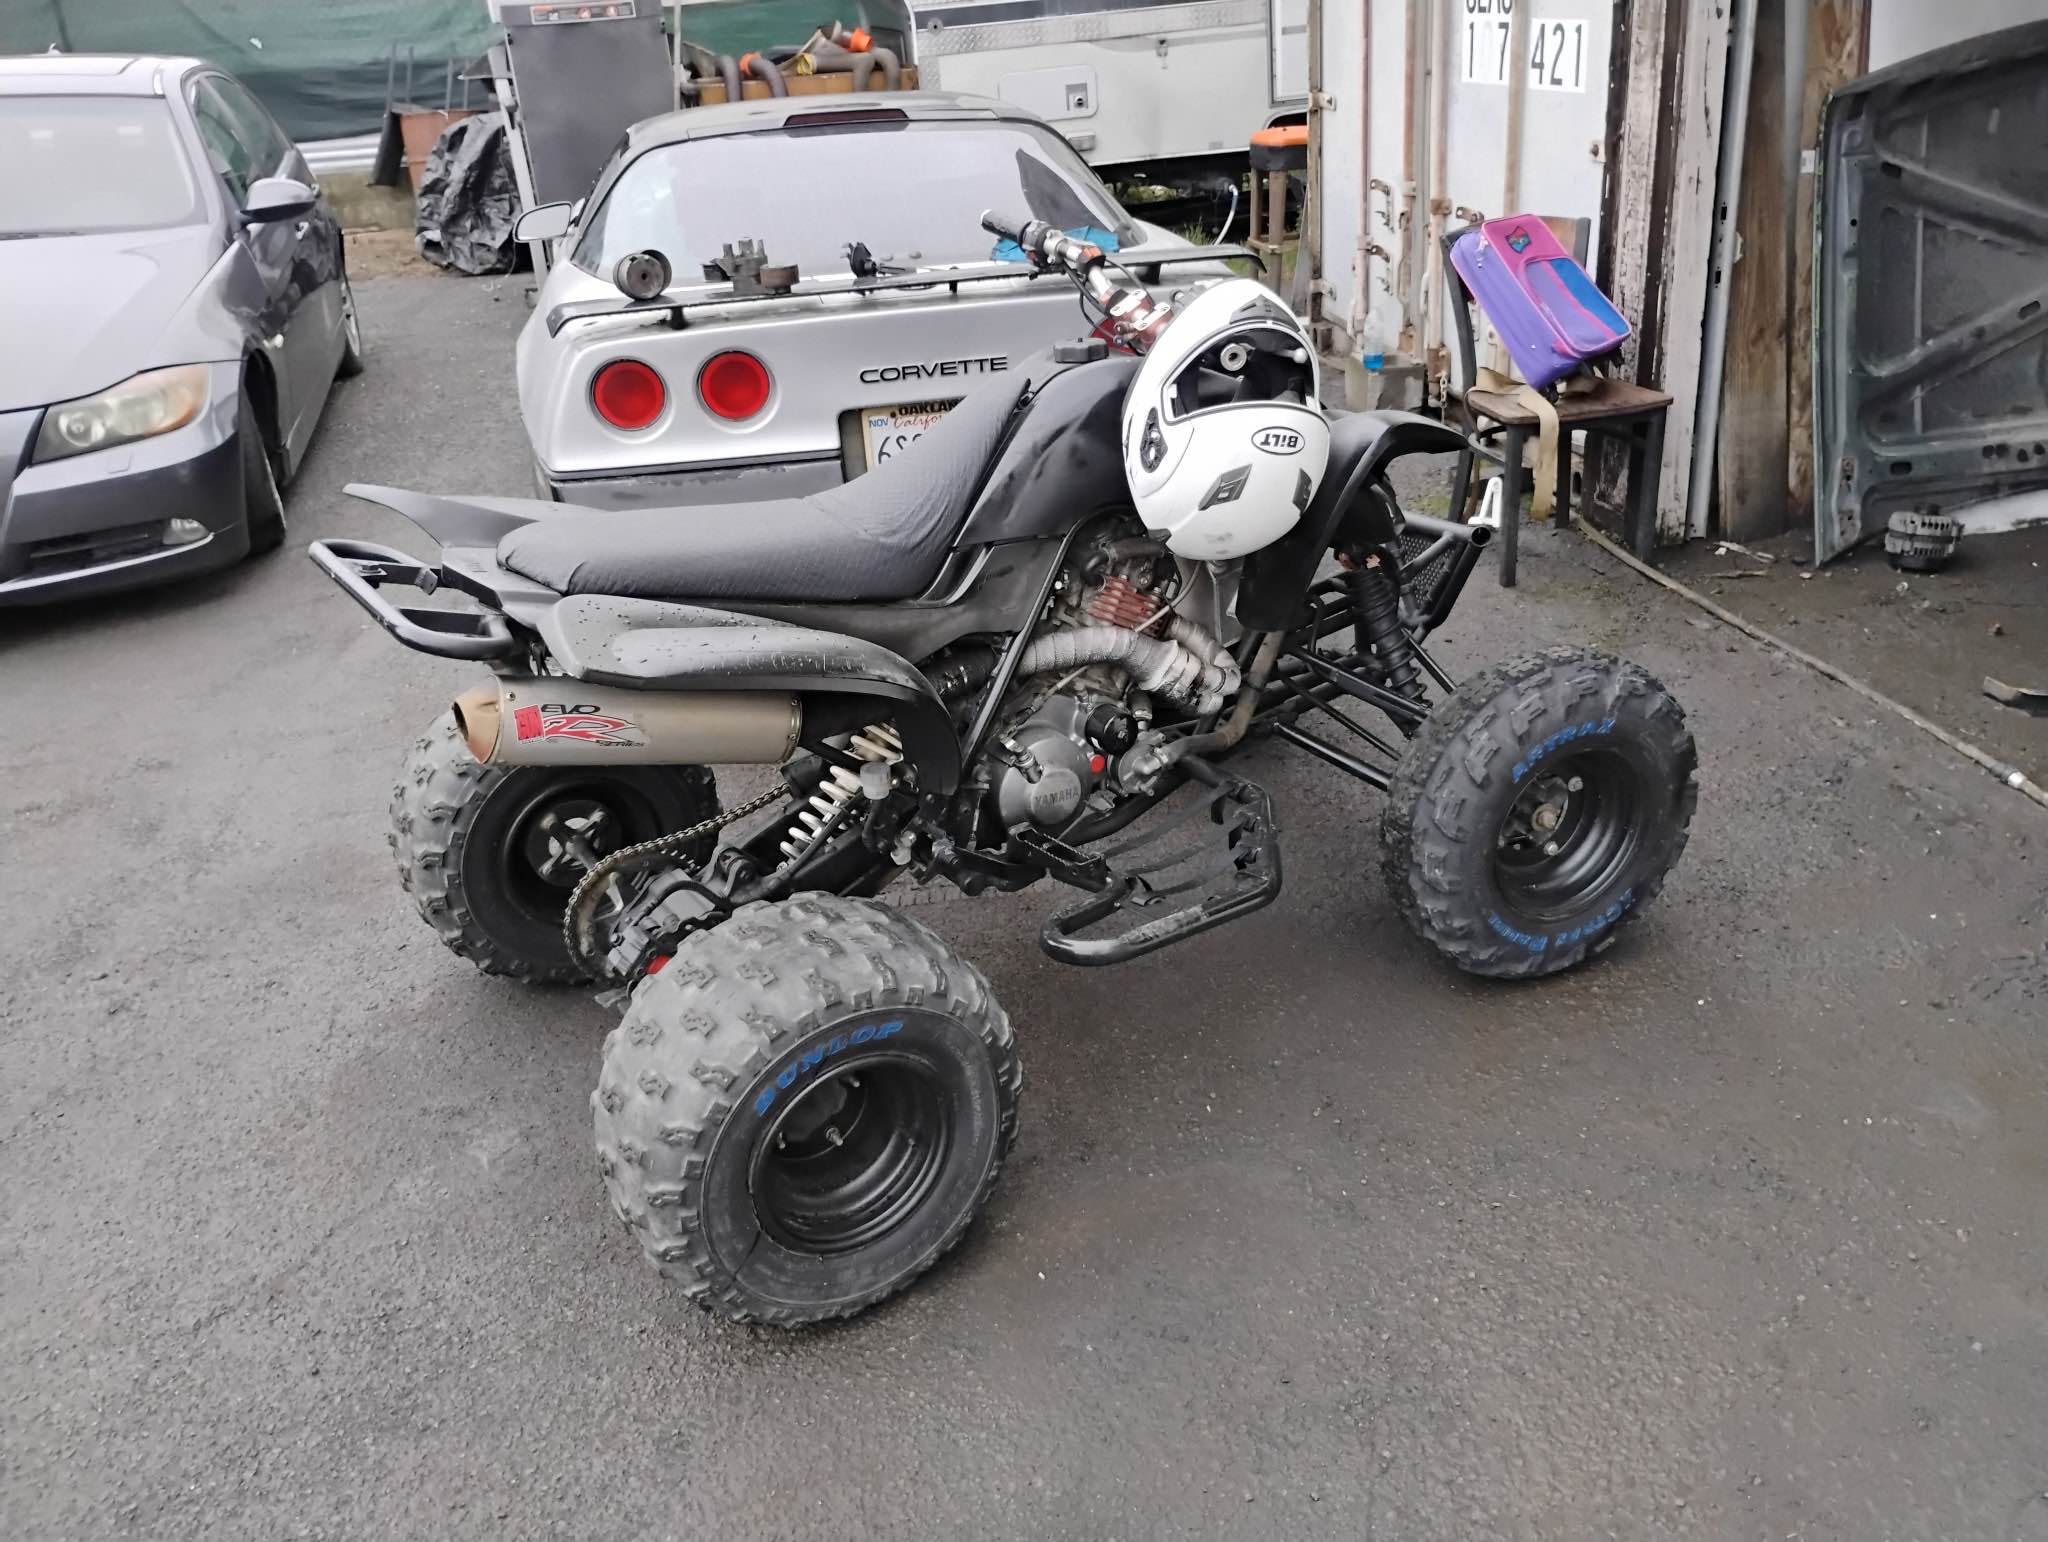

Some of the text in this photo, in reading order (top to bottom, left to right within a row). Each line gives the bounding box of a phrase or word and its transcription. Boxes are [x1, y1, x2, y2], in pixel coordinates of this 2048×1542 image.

[1531, 23, 1583, 87] 421
[859, 356, 1008, 384] CORVETTE
[869, 417, 889, 429] NOV
[541, 703, 601, 715] EVO
[1034, 788, 1080, 804] YAMAHA
[754, 1019, 904, 1118] DUNLOP
